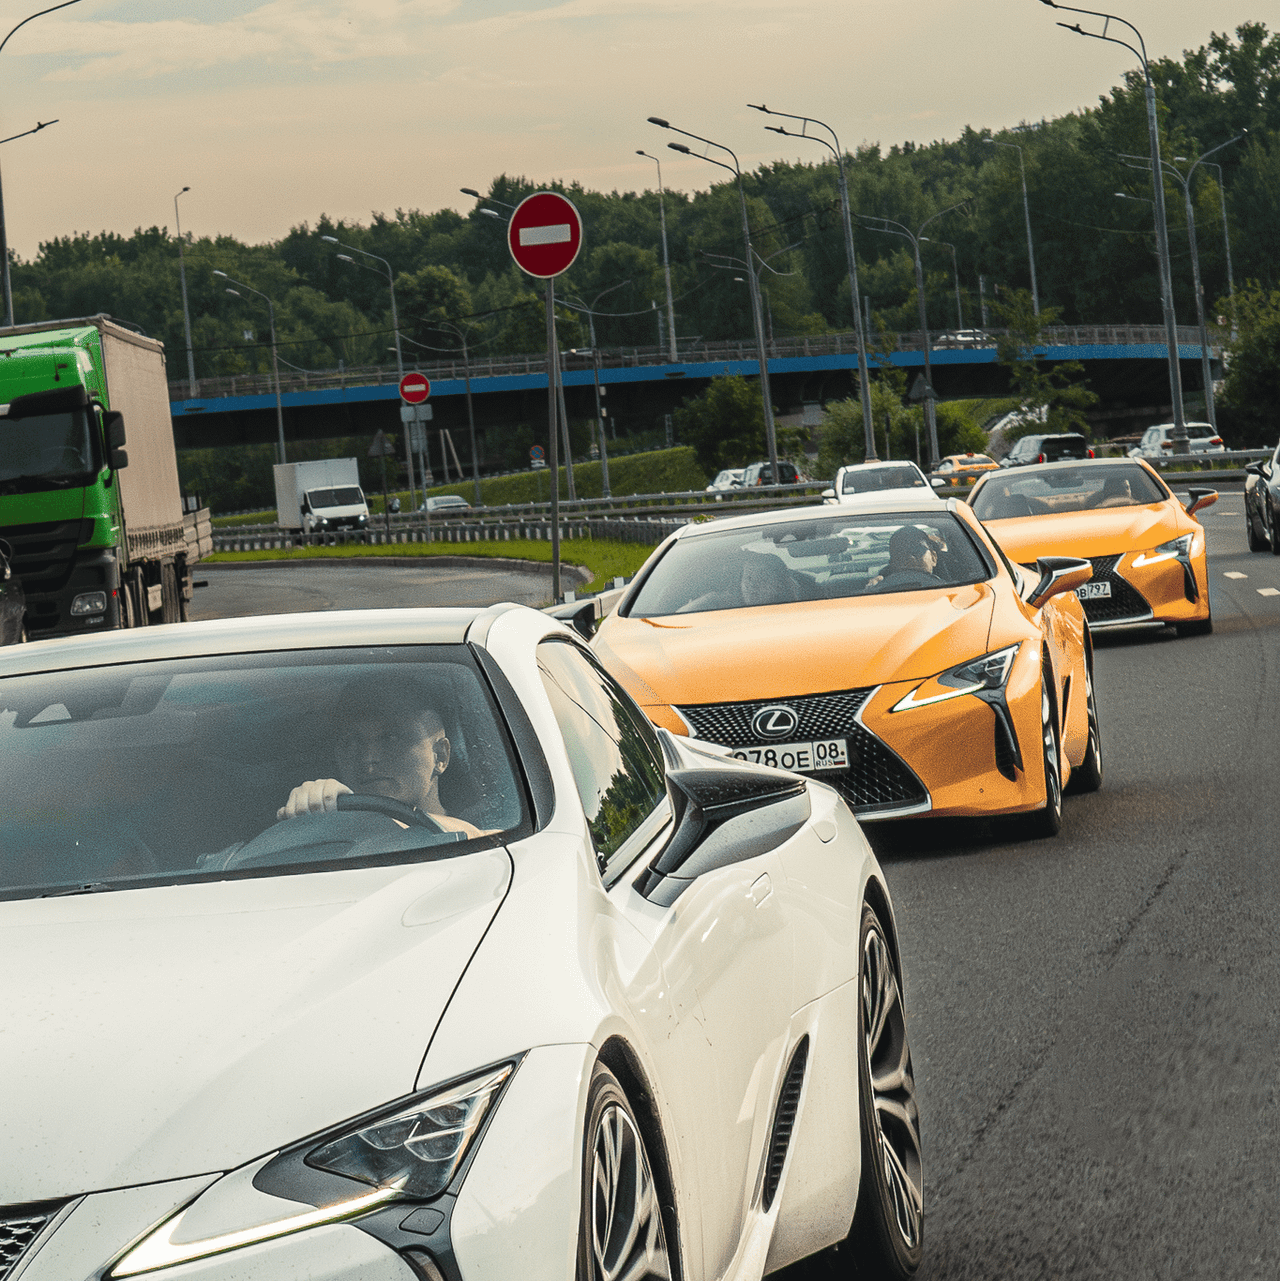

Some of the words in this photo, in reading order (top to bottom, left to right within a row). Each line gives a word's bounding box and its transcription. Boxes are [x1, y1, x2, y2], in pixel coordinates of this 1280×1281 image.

[1088, 584, 1107, 593] 797
[816, 742, 840, 760] 08
[816, 759, 833, 767] RUS
